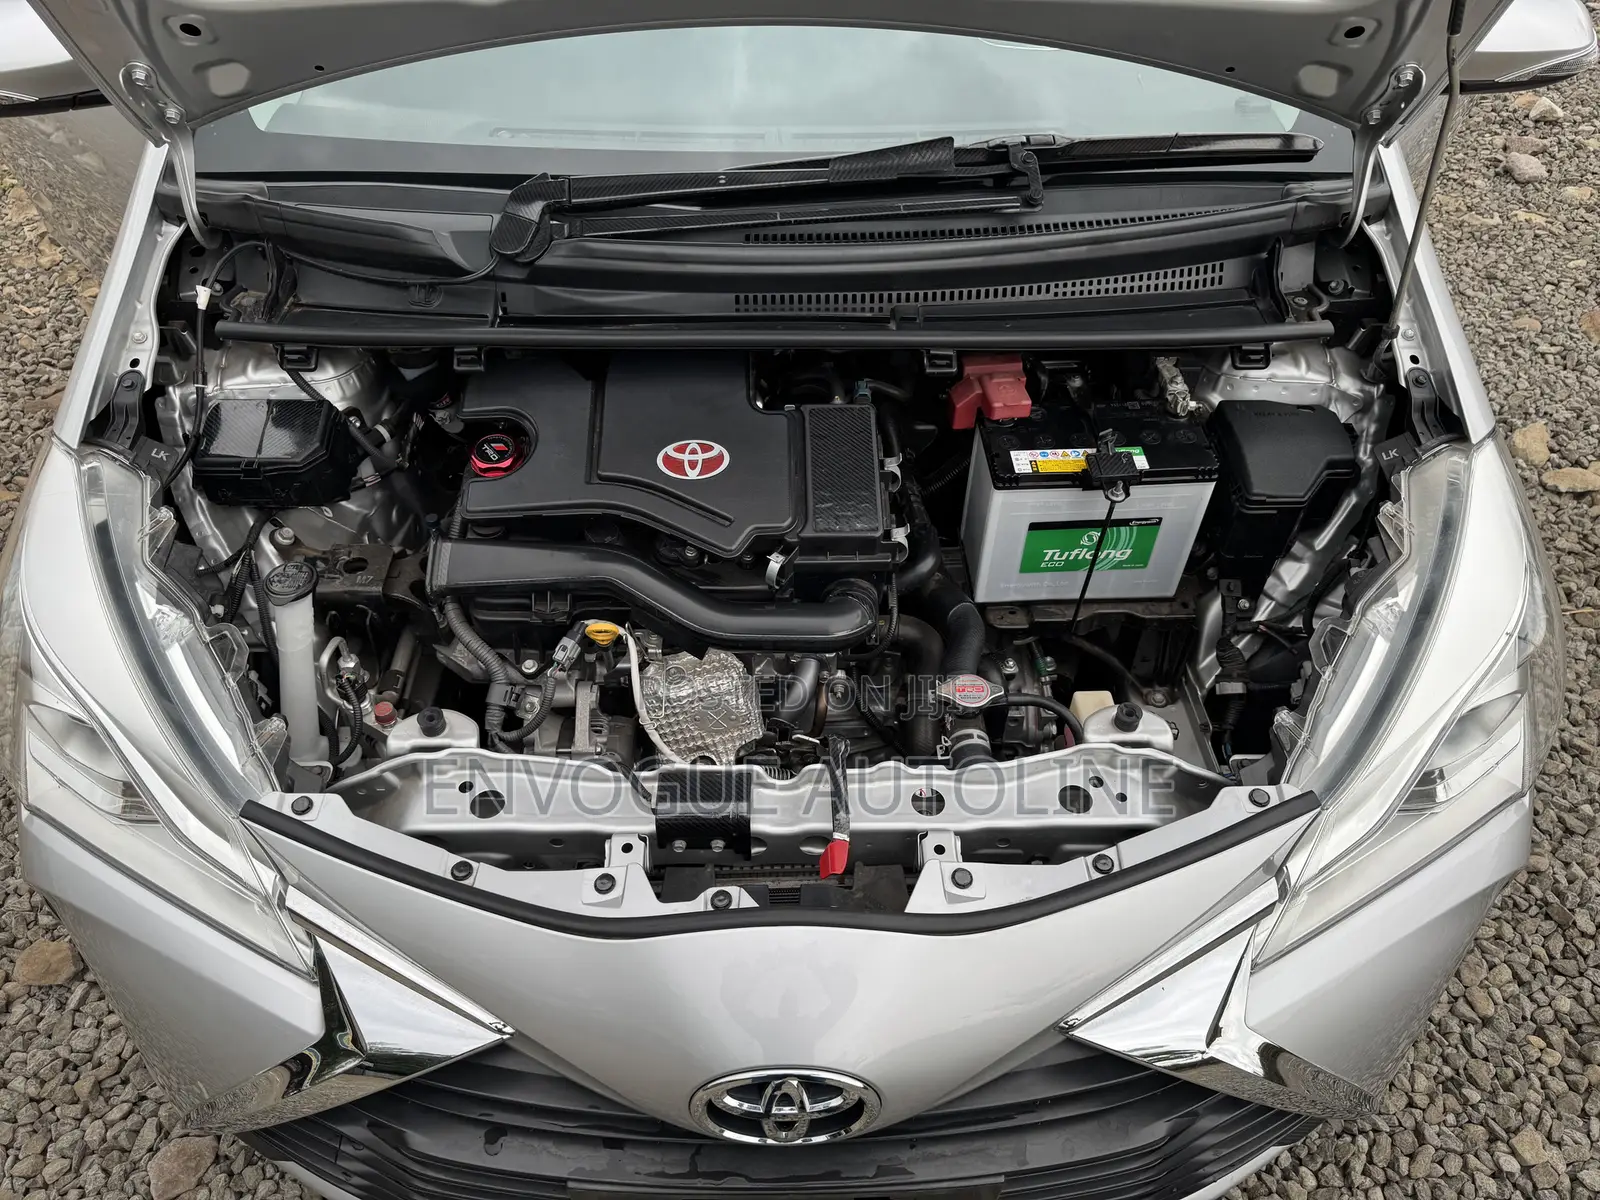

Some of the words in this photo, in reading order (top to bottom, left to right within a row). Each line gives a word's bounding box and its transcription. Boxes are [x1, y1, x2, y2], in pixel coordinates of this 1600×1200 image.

[151, 448, 170, 461] LK
[482, 443, 499, 461] TRD
[1381, 448, 1400, 460] LK
